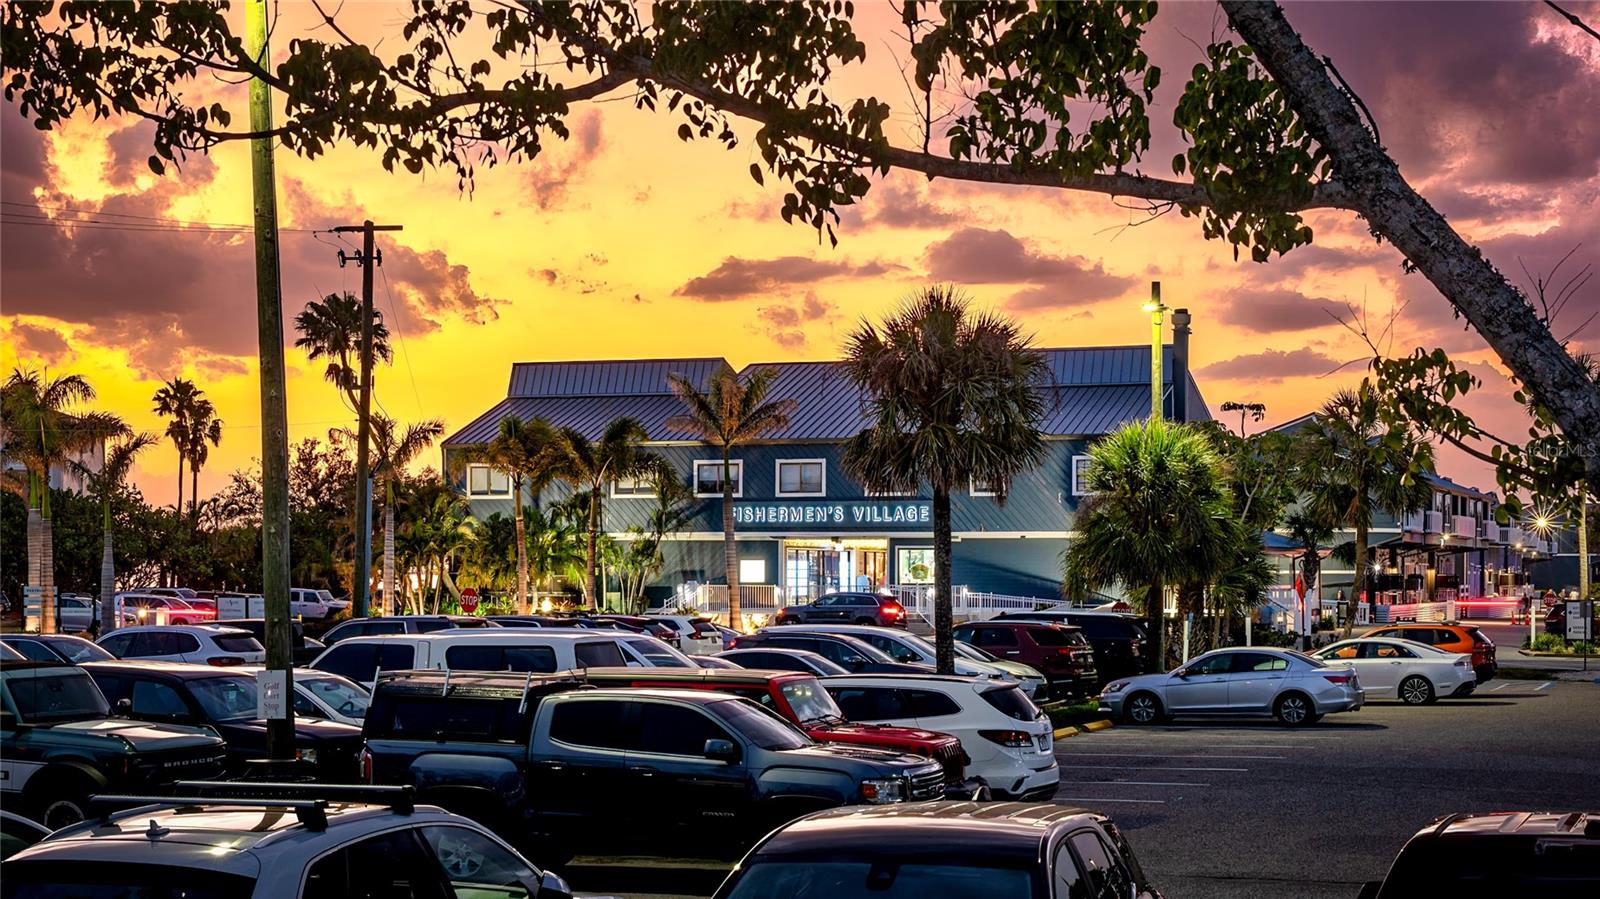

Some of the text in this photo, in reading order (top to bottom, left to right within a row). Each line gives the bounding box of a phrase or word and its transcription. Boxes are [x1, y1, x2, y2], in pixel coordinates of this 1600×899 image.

[852, 505, 930, 523] VILLAGE
[460, 594, 478, 606] STOP
[1544, 596, 1557, 604] STOP
[263, 681, 280, 690] Golf
[263, 702, 280, 712] Stop
[163, 757, 213, 768] BRONCO
